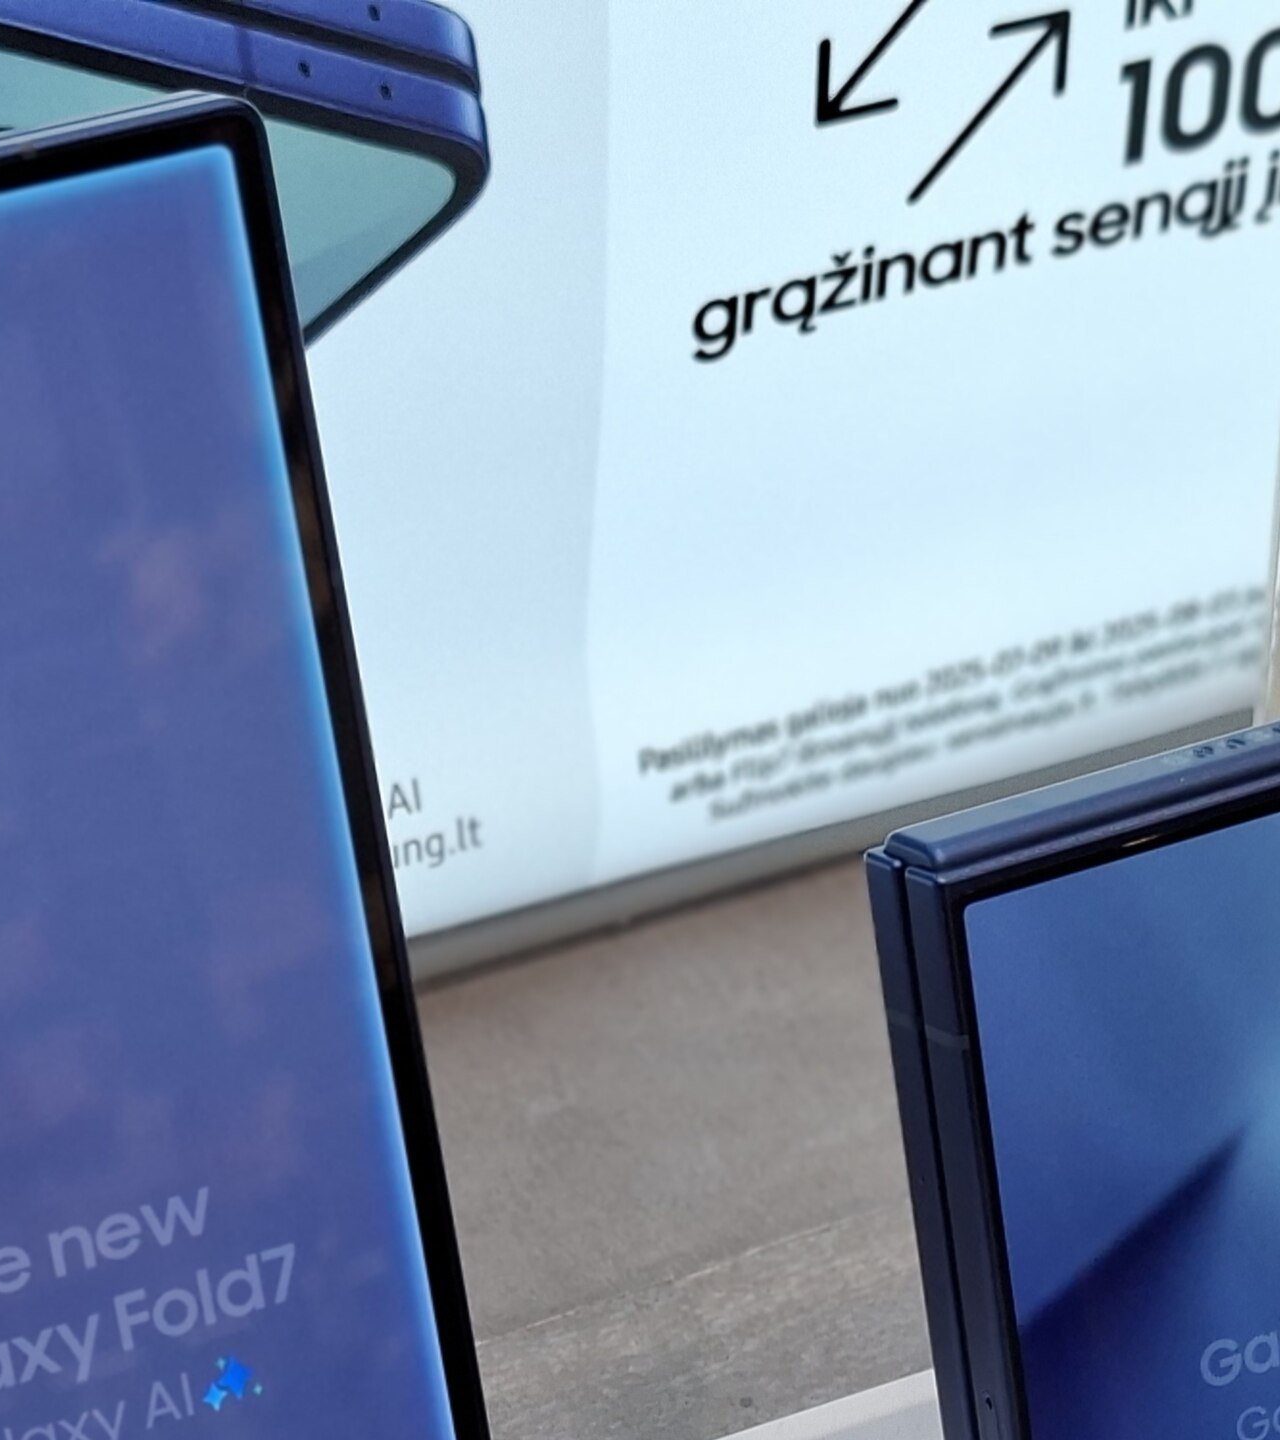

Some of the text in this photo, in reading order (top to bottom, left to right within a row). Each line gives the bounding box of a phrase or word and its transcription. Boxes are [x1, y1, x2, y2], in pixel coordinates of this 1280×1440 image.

[692, 212, 1034, 363] grąžinant
[1051, 158, 1249, 258] senąjį
[392, 817, 482, 870] ng.lt
[47, 1186, 210, 1278] new
[113, 1243, 296, 1352] Fold7
[145, 1373, 195, 1429] AI
